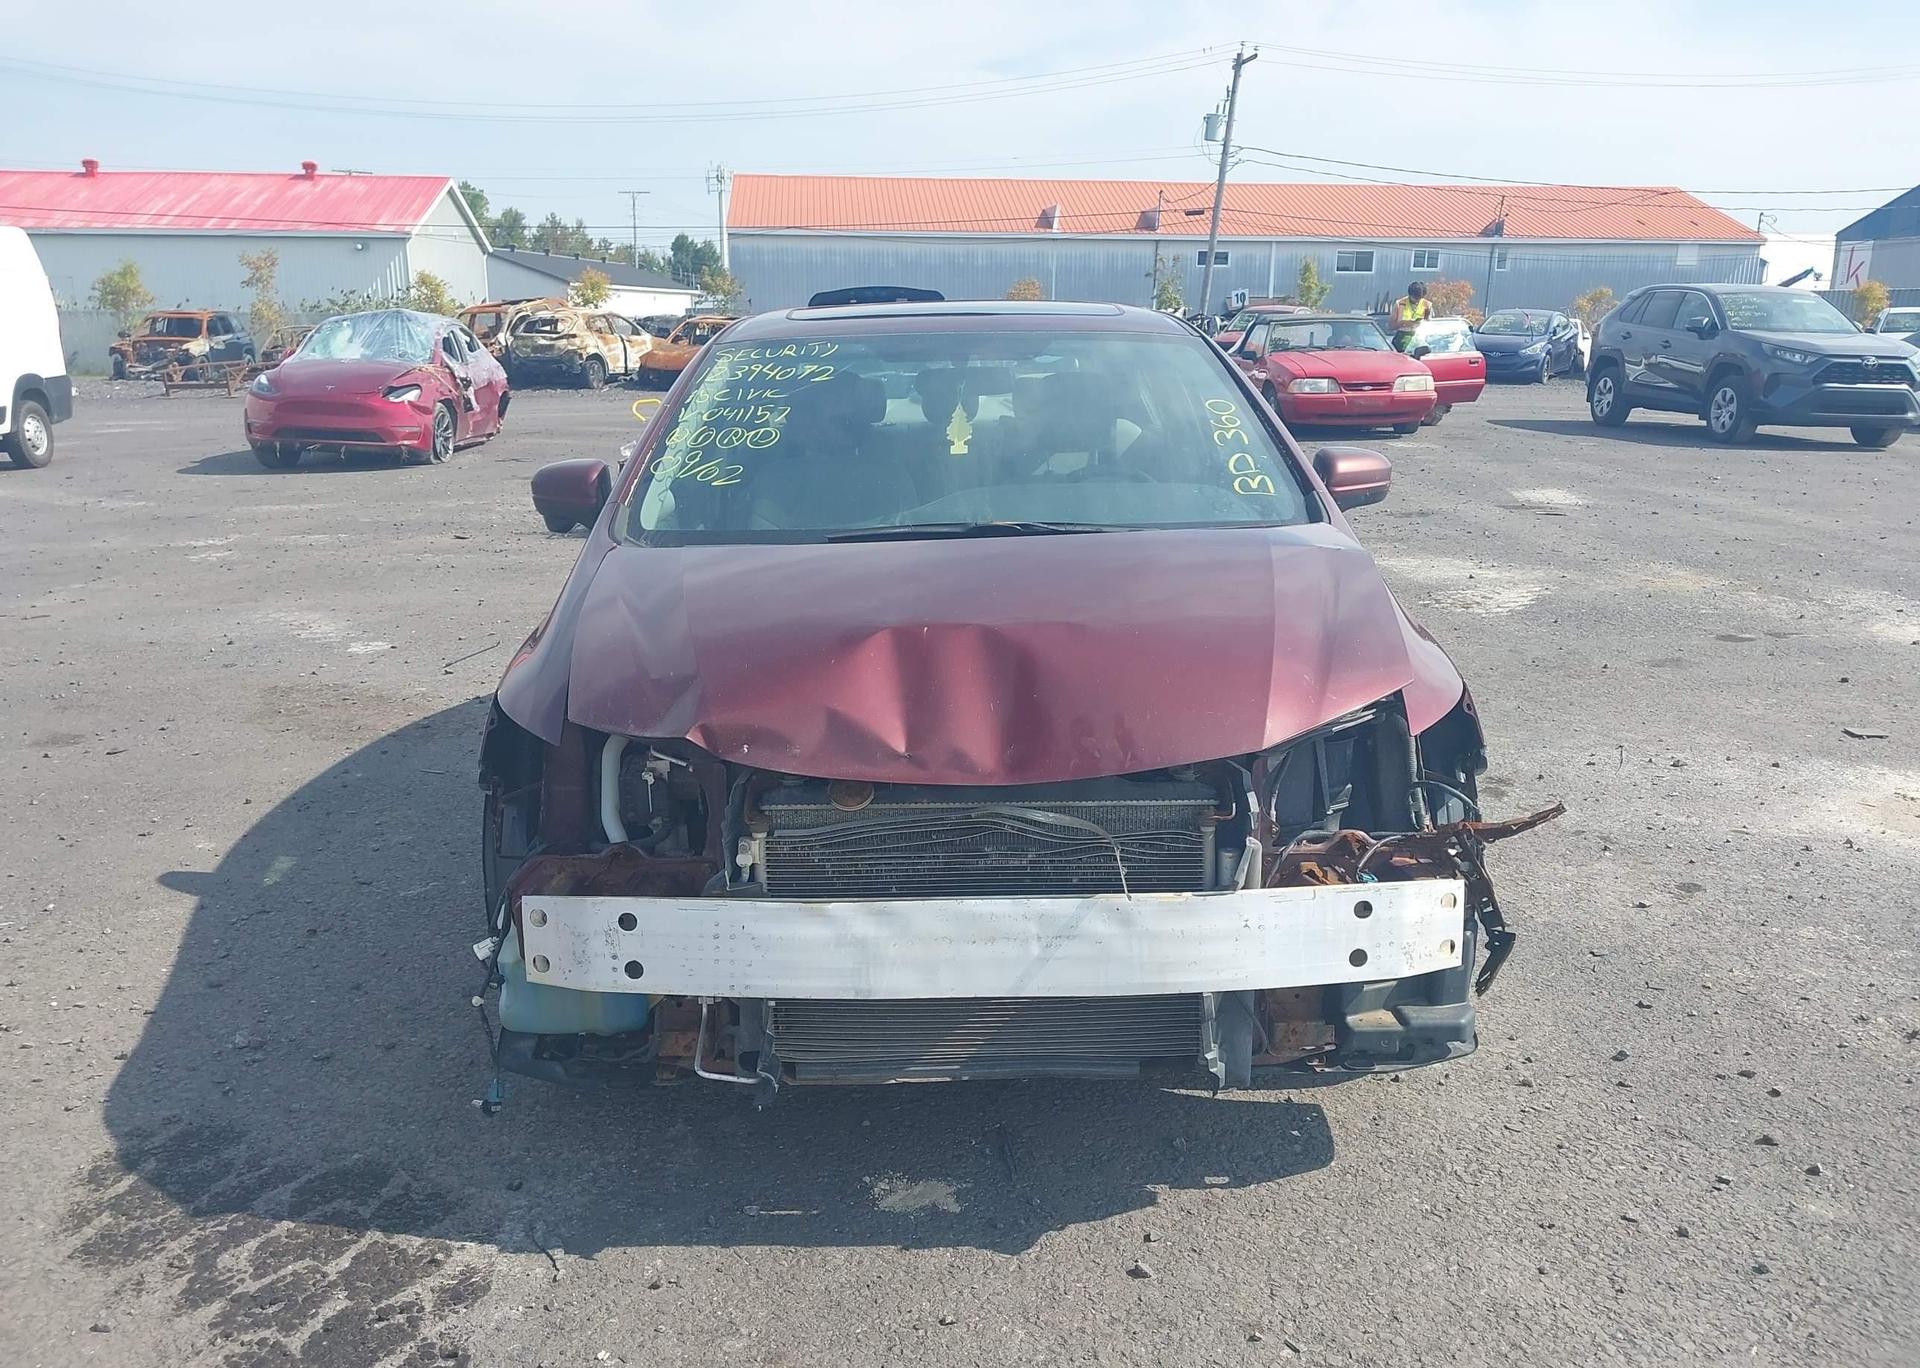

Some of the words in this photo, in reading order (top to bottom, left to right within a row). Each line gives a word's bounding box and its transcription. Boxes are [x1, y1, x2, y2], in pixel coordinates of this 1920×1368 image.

[1234, 292, 1247, 304] 10
[715, 341, 839, 363] SECURITY
[696, 362, 836, 386] 12394072
[1205, 399, 1248, 446] 360
